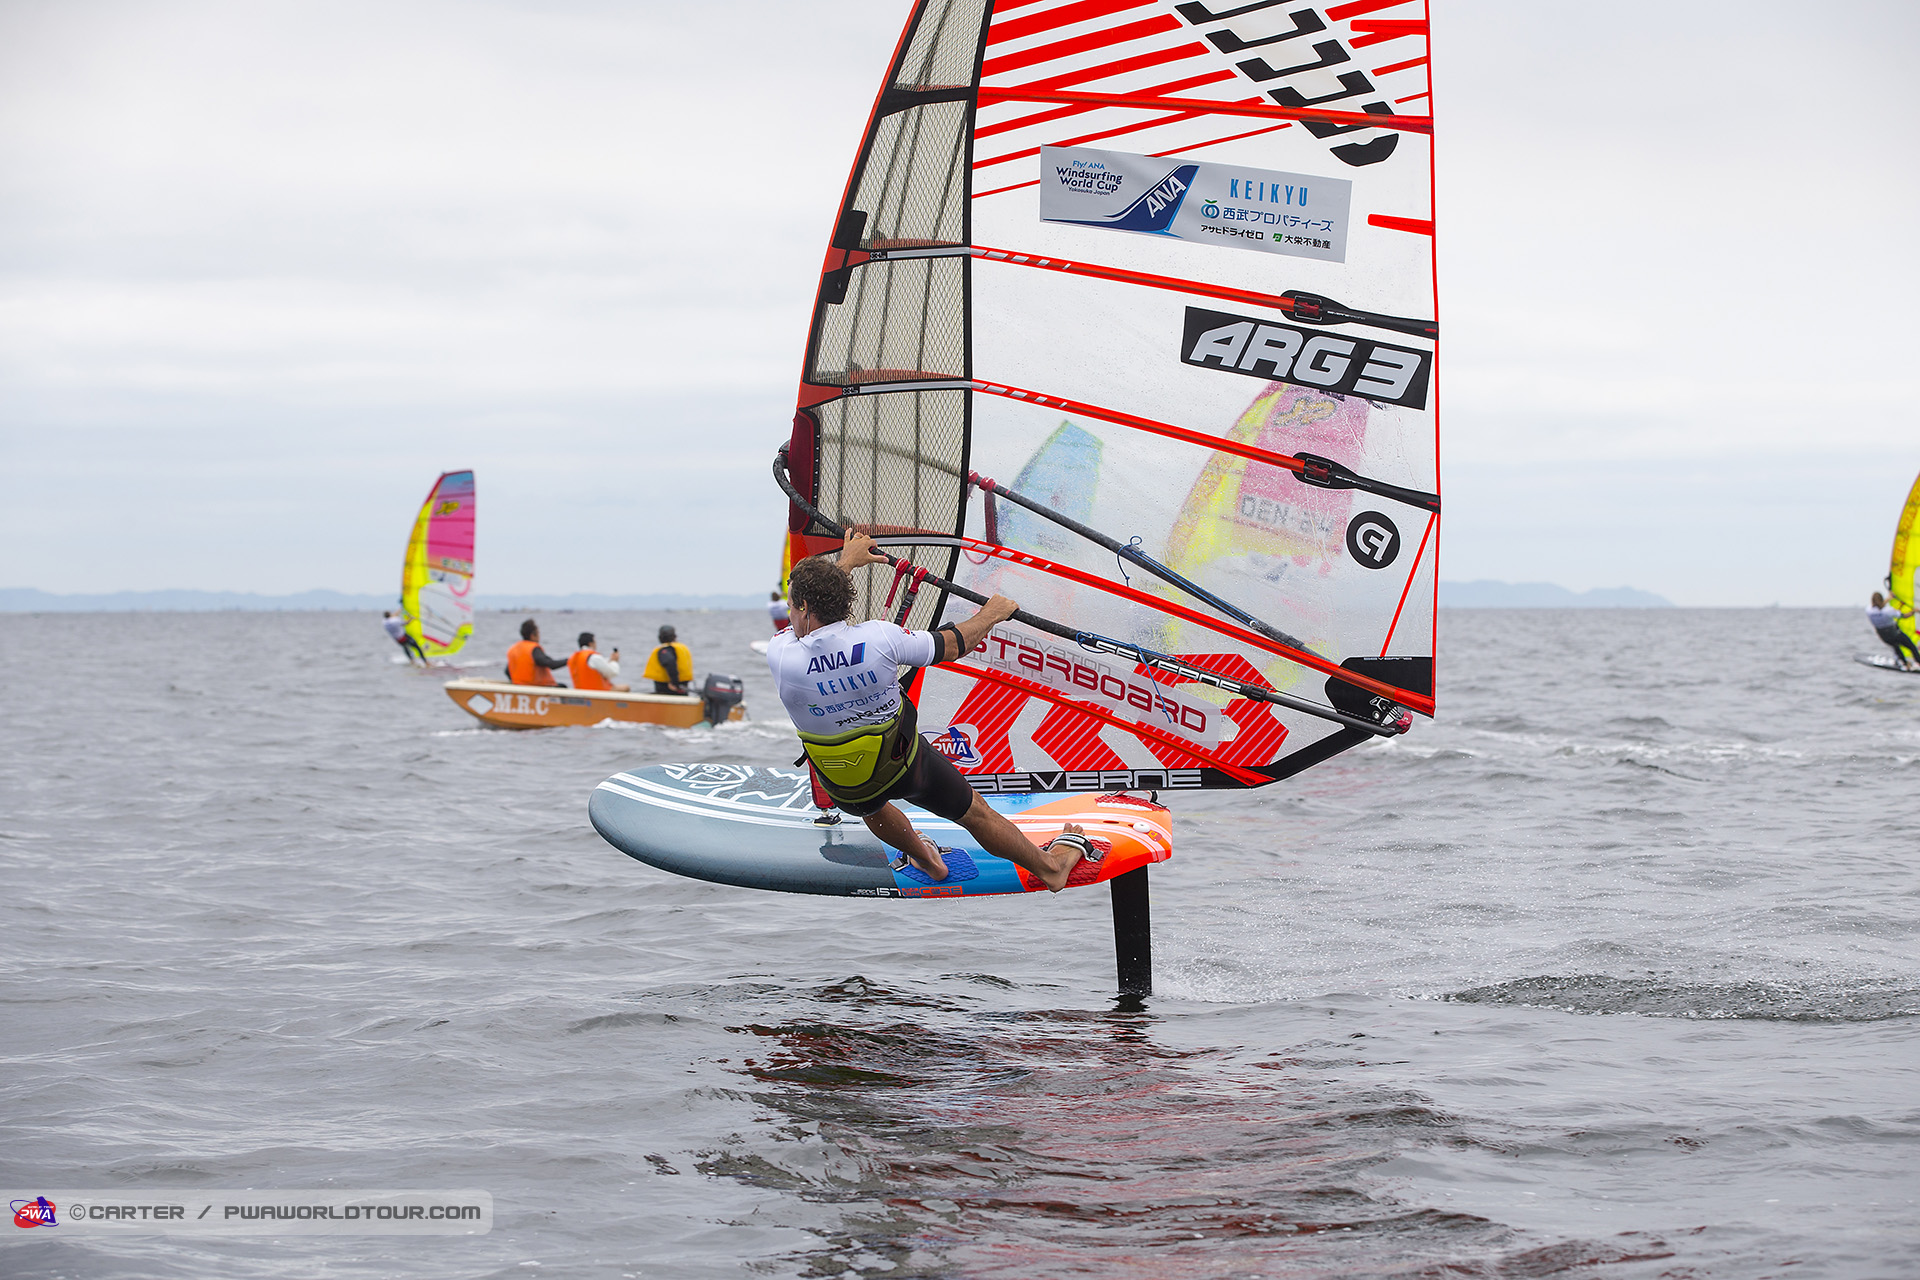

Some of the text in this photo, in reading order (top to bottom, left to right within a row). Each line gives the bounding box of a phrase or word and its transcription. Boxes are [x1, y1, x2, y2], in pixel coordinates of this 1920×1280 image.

[1056, 166, 1123, 185] Windsurfing
[1088, 162, 1105, 170] ANA
[1060, 176, 1119, 194] World Cup
[1146, 175, 1187, 219] ANA
[1230, 178, 1308, 207] KEIKYU
[1223, 206, 1334, 232] 西武プロパティーズ
[806, 650, 850, 675] ANA
[1095, 640, 1242, 693] SEVERNE
[817, 670, 878, 697] KEIKYU
[932, 742, 968, 755] PWA
[966, 769, 1202, 792] SEVERNE
